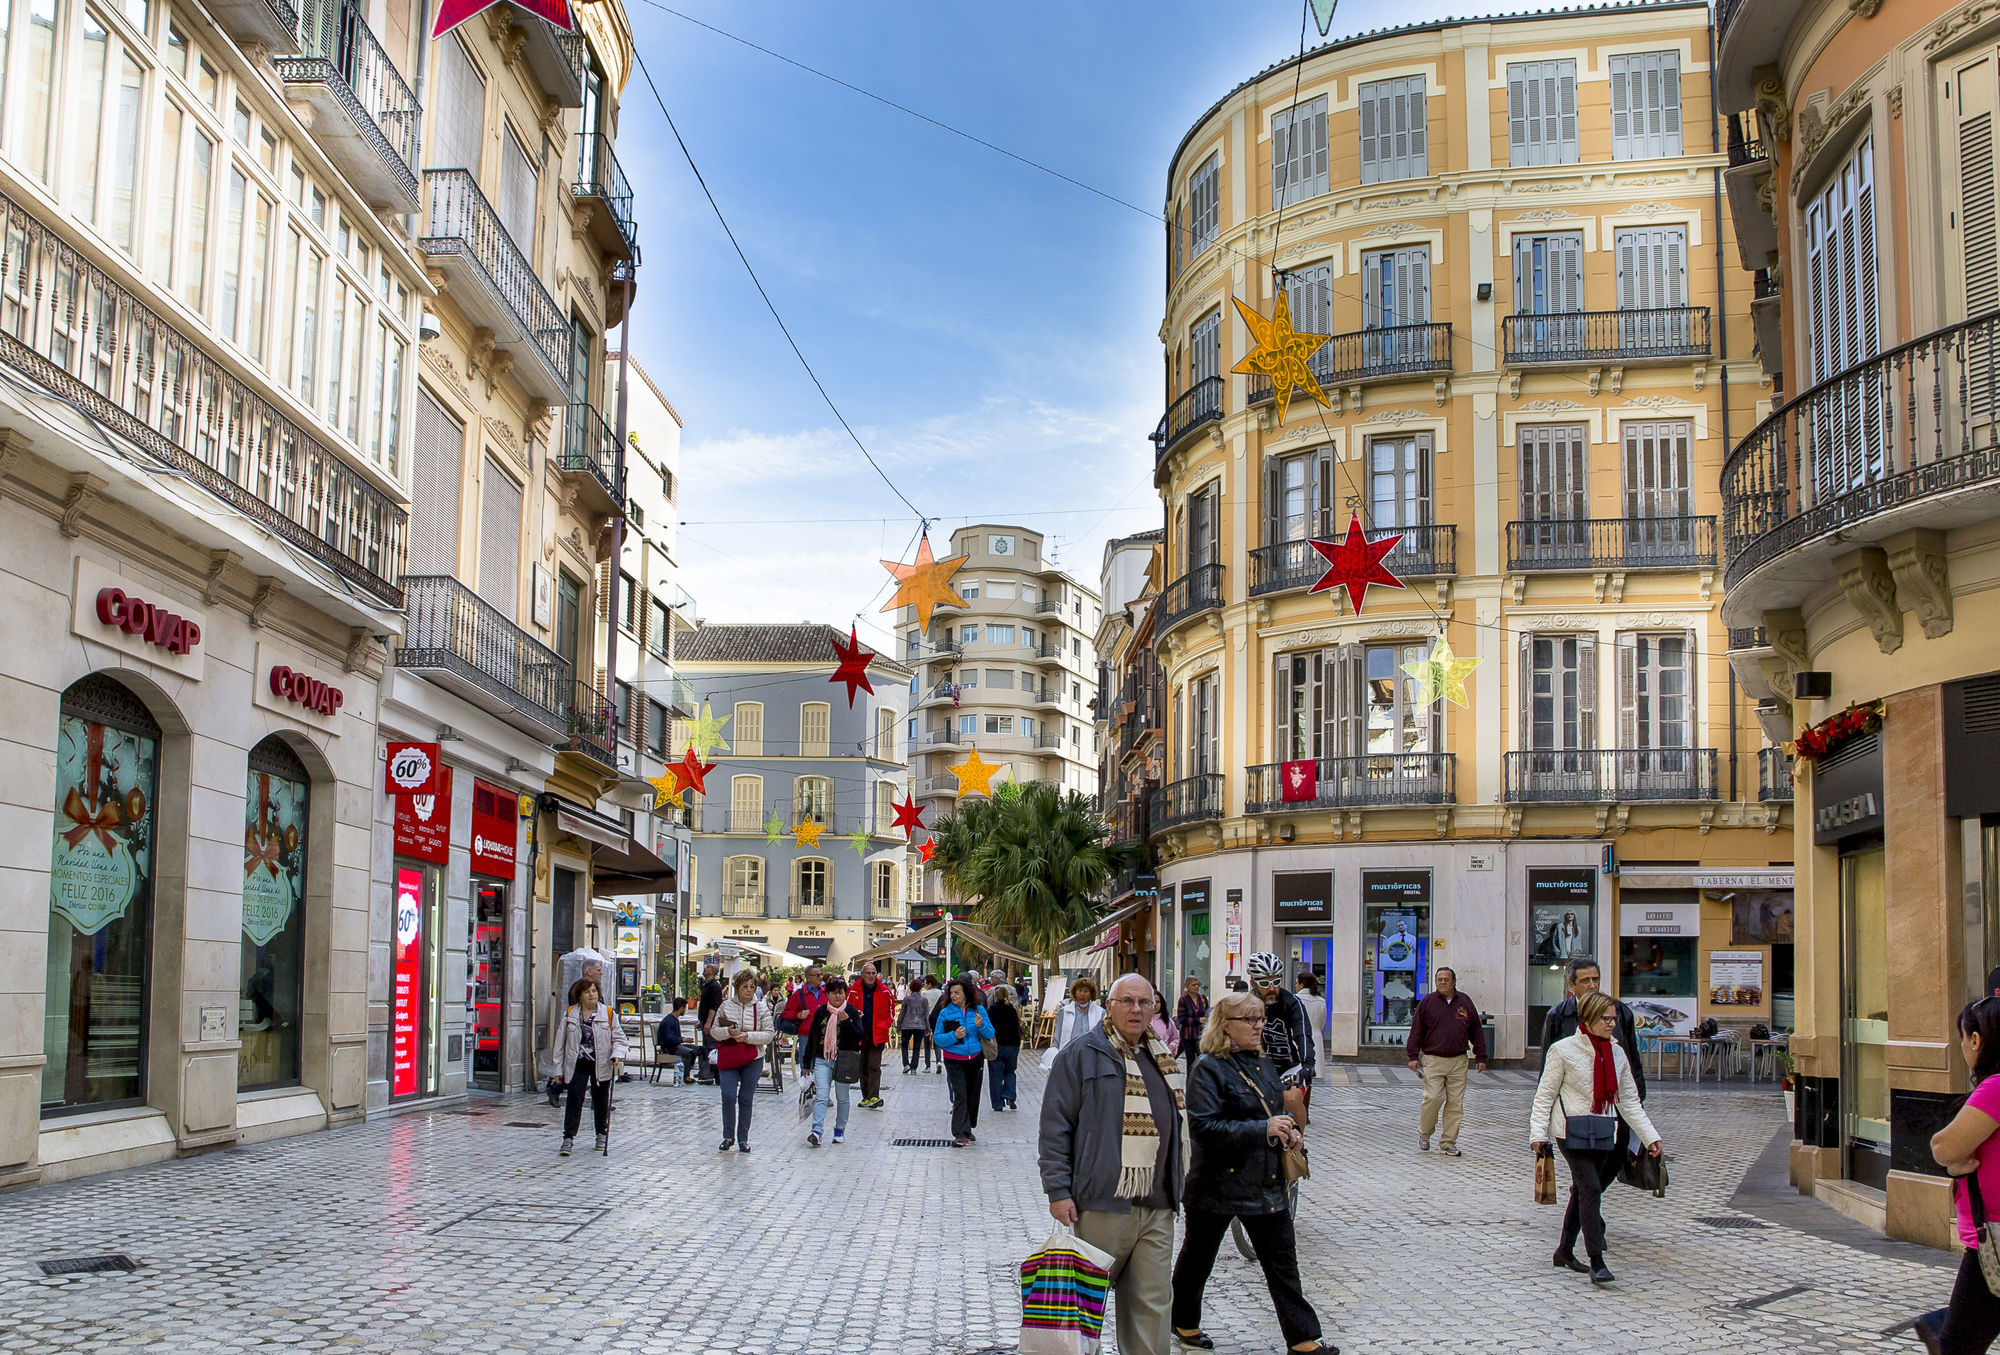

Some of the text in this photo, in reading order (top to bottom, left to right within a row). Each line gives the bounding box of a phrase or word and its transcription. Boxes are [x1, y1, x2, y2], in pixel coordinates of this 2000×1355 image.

[96, 587, 201, 654] COVAP
[270, 665, 343, 716] COVAP
[396, 758, 427, 778] 60%
[58, 854, 88, 869] Navidad
[52, 868, 128, 887] MOMENTOS ESPECIALES
[62, 882, 116, 902] FELIZ 2016
[262, 906, 278, 920] 2016
